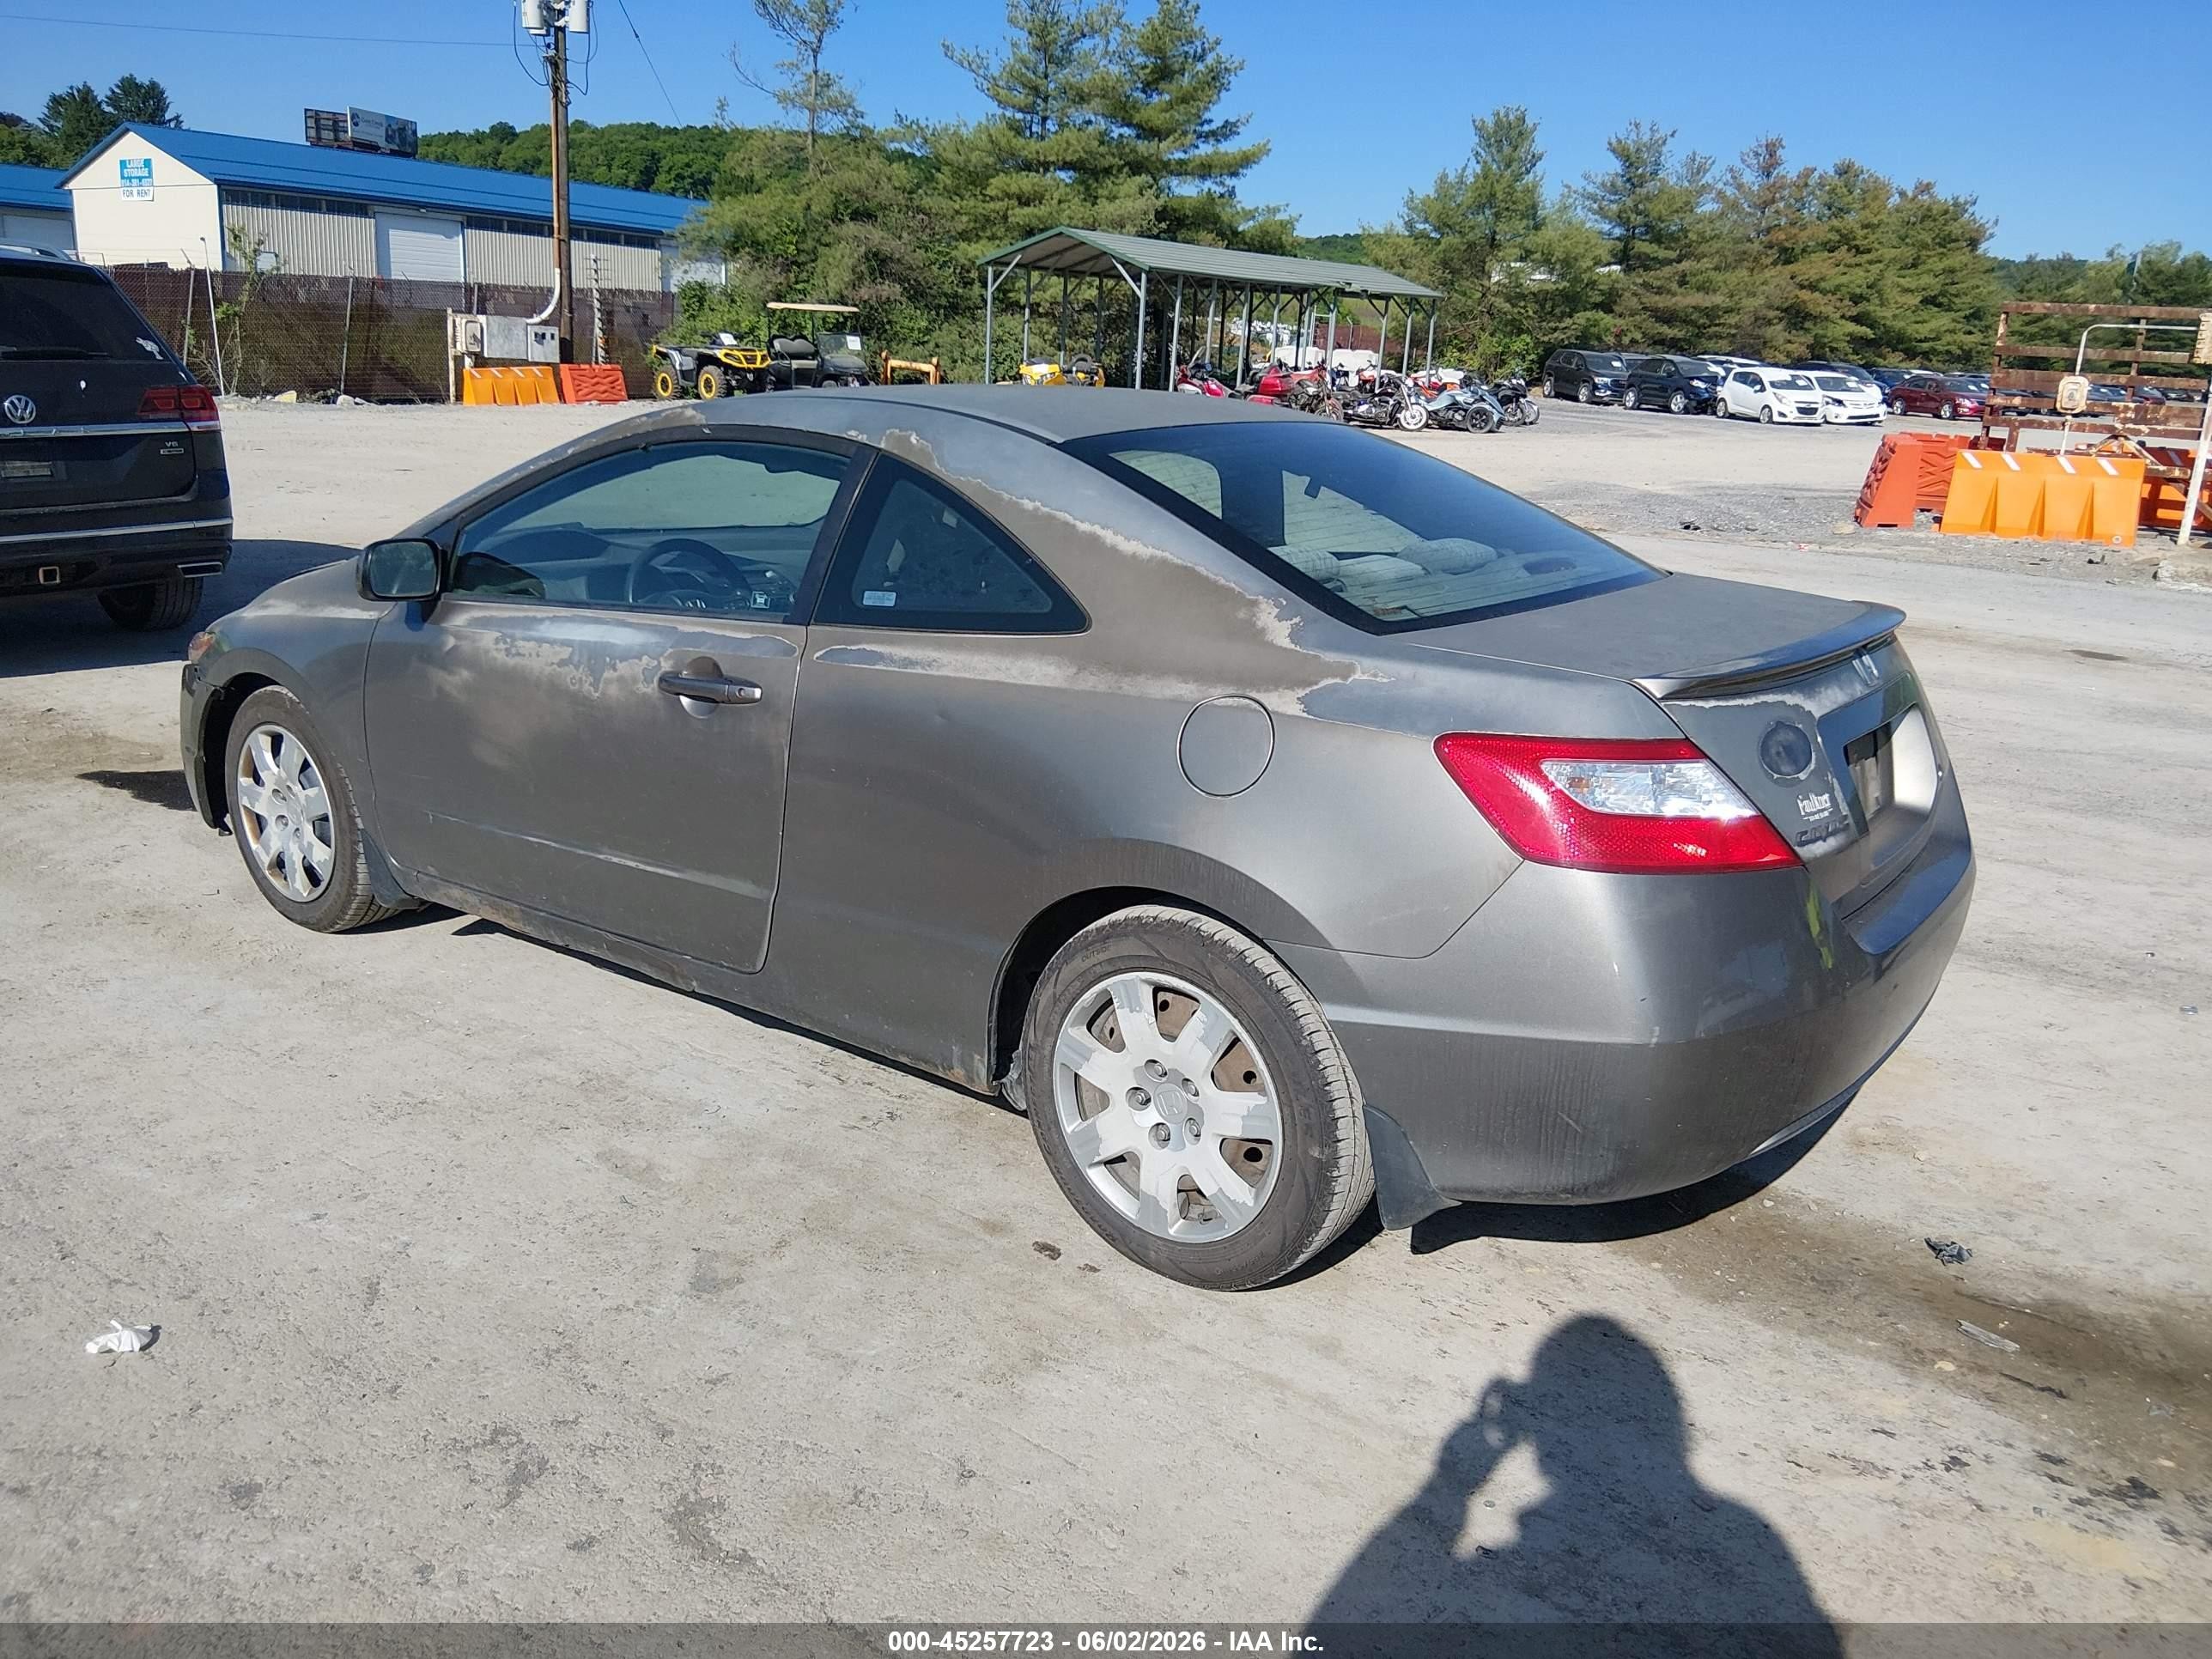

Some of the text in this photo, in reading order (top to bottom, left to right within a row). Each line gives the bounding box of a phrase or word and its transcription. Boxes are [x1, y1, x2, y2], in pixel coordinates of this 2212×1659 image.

[125, 158, 145, 167] LARGE
[123, 167, 149, 177] STORAGE
[122, 189, 150, 198] FOR RENT
[1796, 793, 1832, 816] Faulkner
